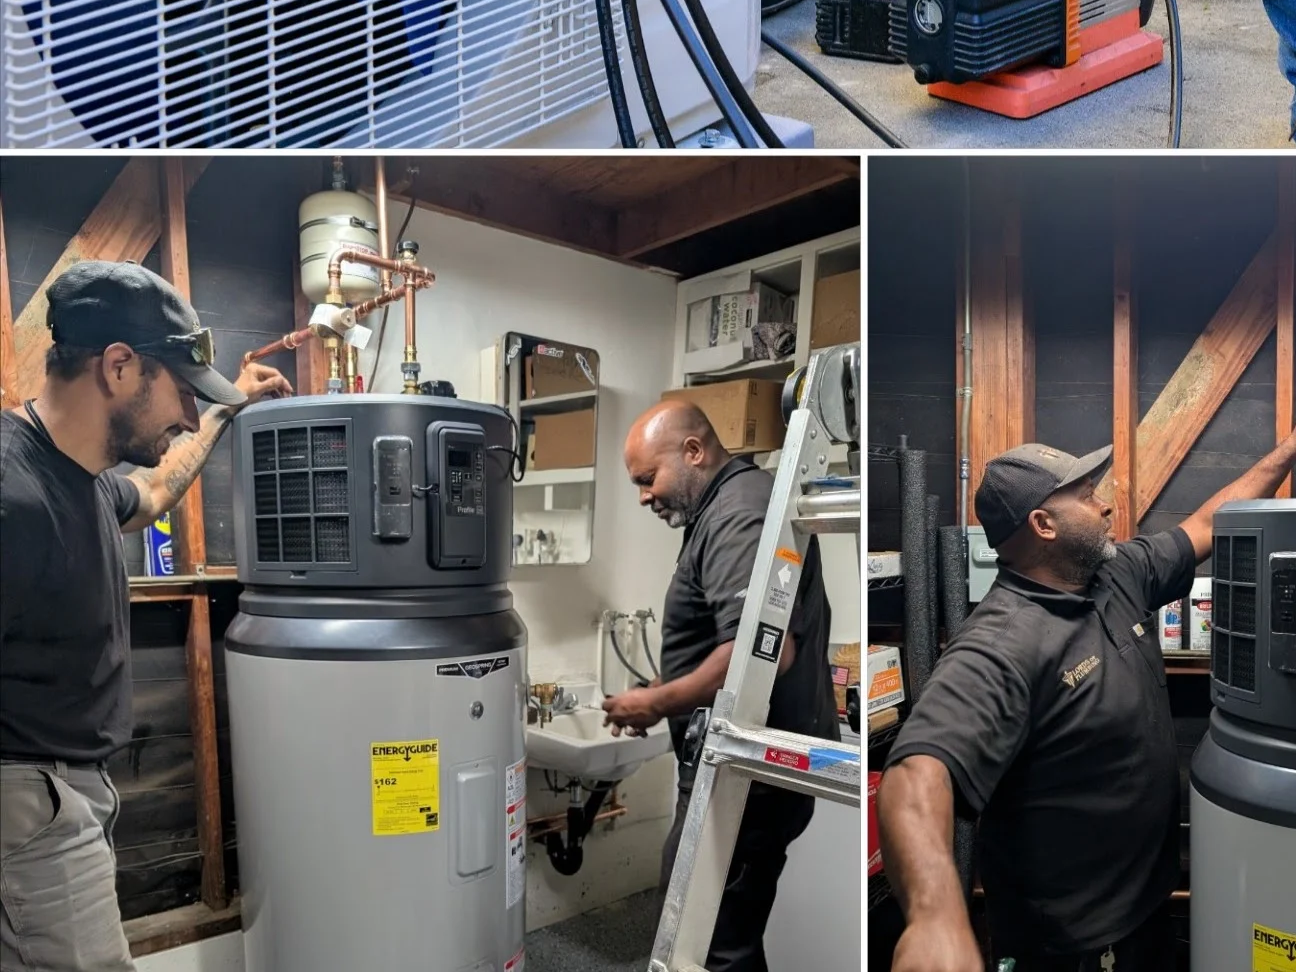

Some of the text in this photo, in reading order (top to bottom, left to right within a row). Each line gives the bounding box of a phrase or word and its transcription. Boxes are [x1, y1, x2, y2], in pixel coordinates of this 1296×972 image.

[722, 302, 730, 336] water
[372, 743, 438, 757] ENERGYGUIDE
[374, 777, 397, 786] $162
